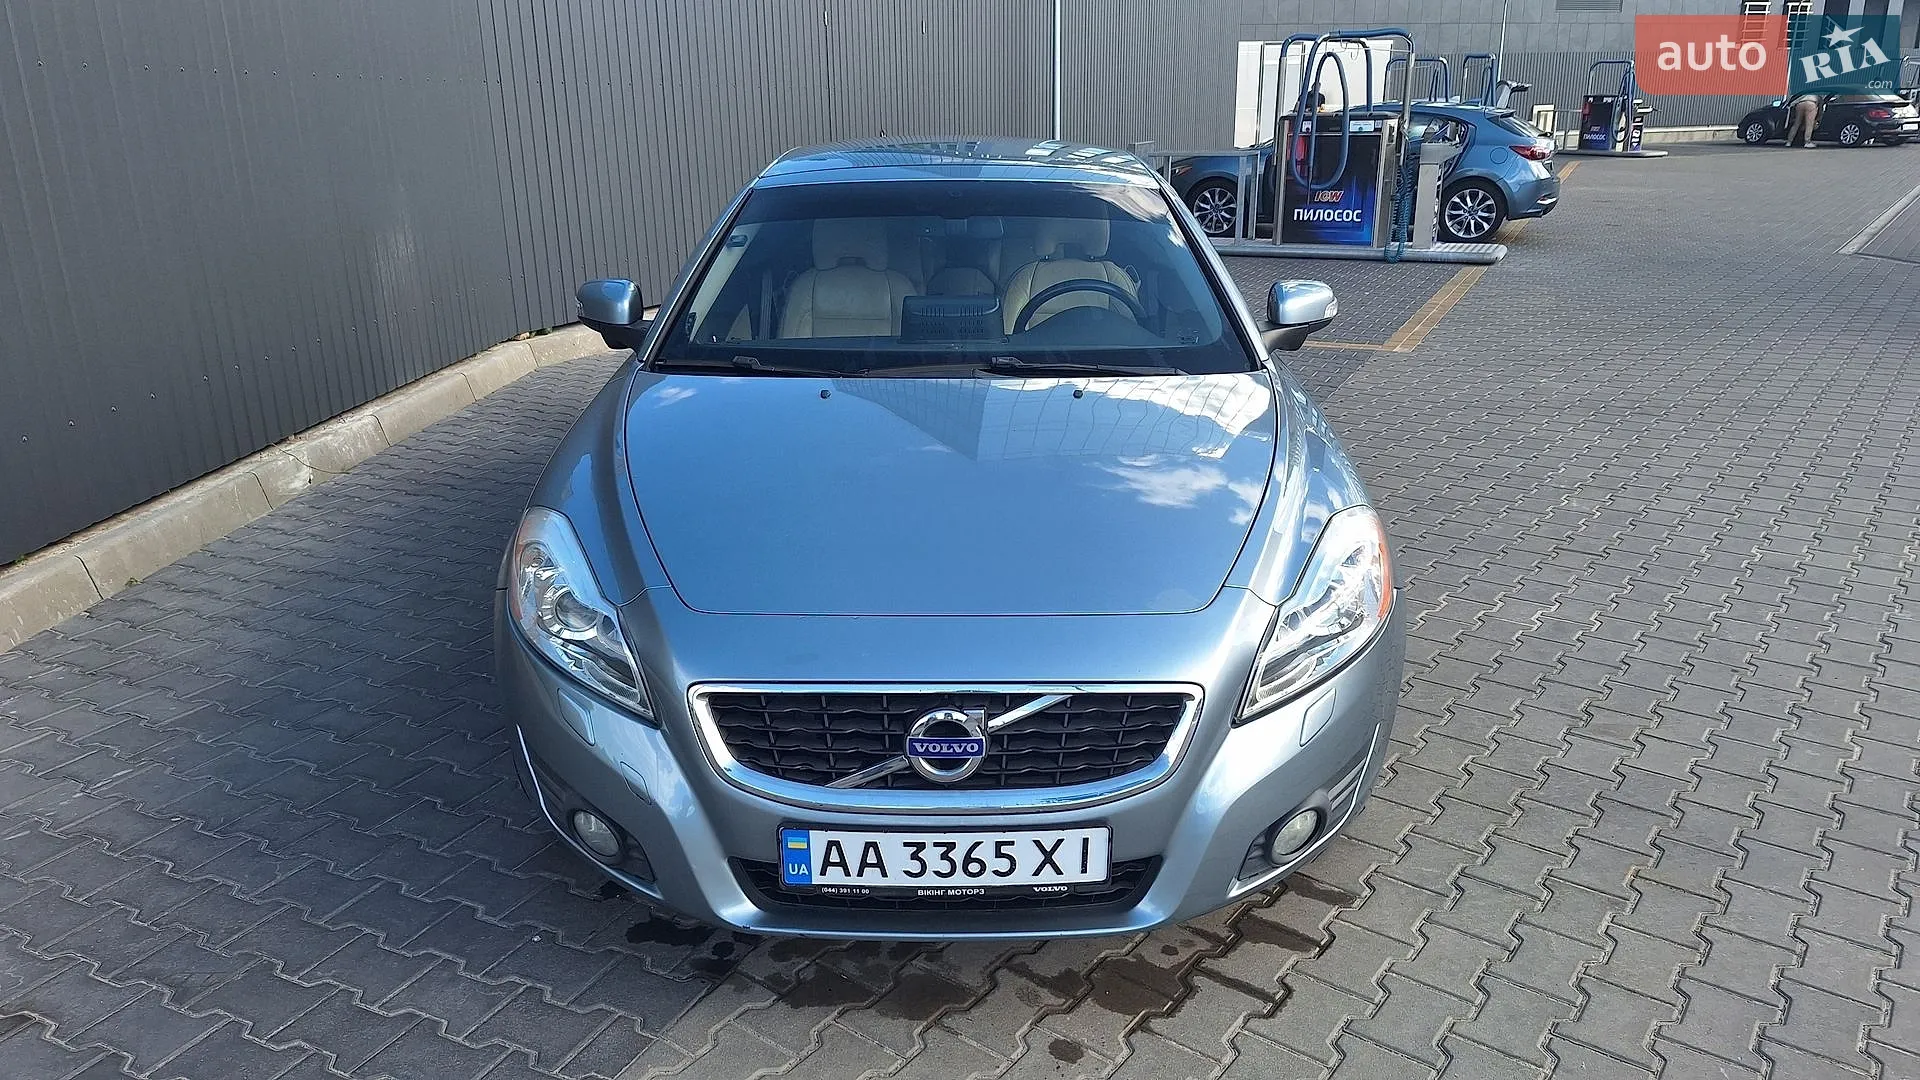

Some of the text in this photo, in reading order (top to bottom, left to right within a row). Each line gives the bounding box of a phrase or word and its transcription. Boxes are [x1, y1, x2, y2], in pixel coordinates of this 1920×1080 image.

[1293, 208, 1362, 222] ПИЛОСОС
[913, 742, 979, 753] VOLVO
[789, 863, 809, 876] UA
[819, 839, 889, 879] AA
[902, 840, 1018, 879] 3365
[917, 888, 985, 897] ВІКІНГ МОТОРЗ
